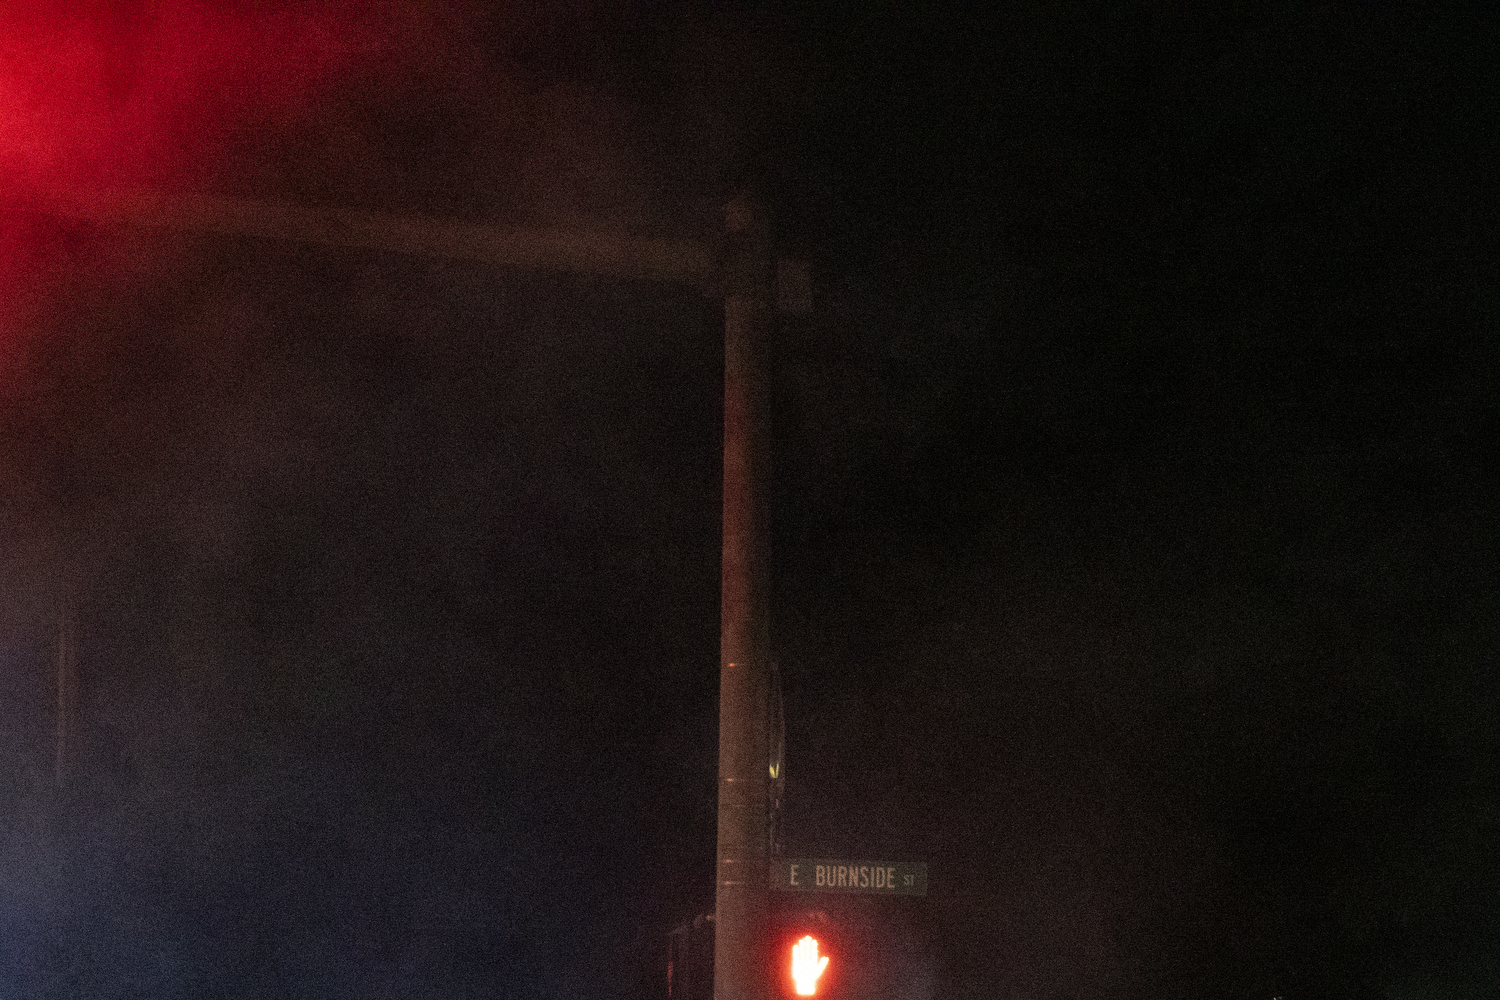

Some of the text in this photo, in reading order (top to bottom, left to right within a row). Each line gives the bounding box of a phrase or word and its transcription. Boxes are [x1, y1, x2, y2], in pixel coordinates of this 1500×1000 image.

[790, 864, 915, 888] E BURNSIDE ST
